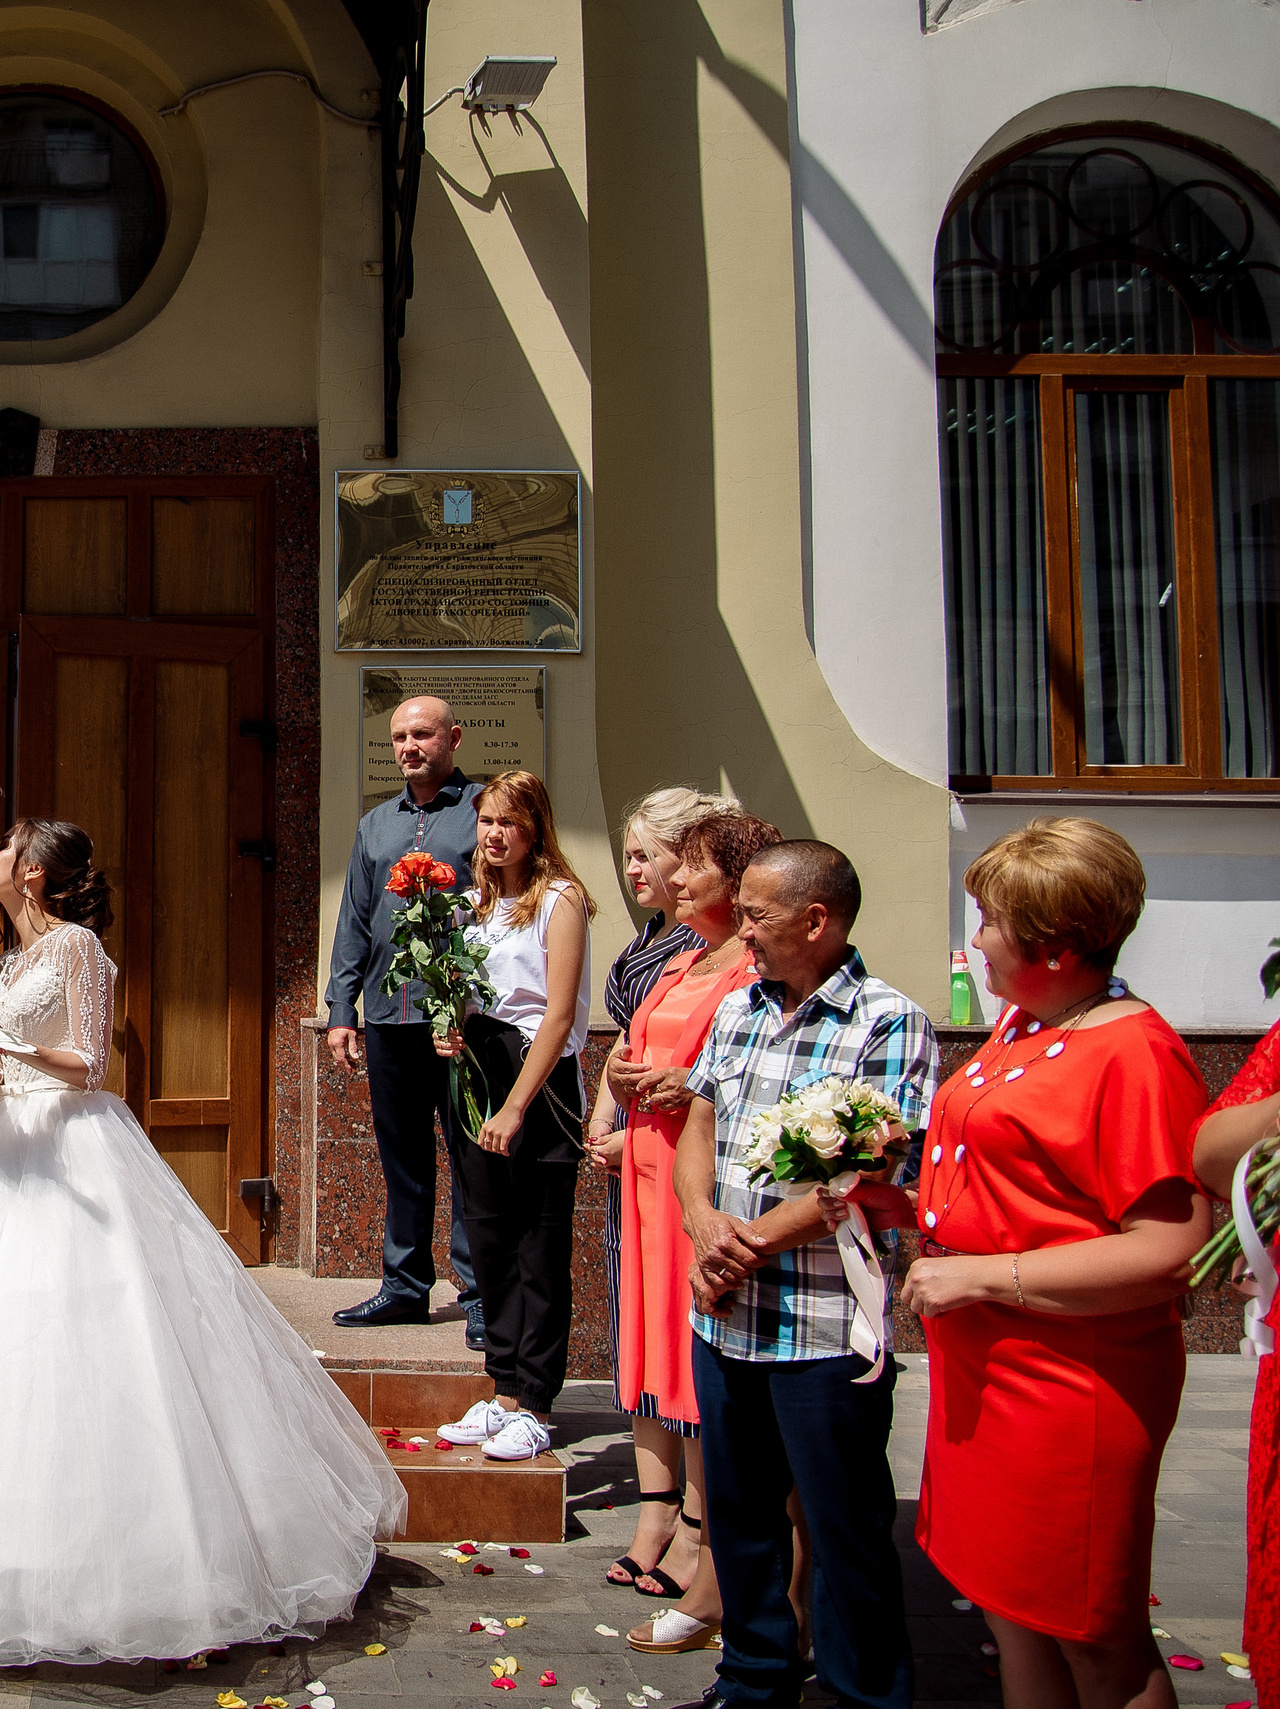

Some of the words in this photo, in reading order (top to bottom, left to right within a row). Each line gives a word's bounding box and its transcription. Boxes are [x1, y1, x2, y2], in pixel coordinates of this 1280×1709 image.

[416, 540, 497, 552] Управление
[377, 577, 503, 587] СПЕЦИАЛИЗИРОВАННЫЙ
[505, 578, 538, 587] ОТДЕЛ
[372, 587, 472, 596] ГОСУДАРСТВЕННОЙ
[474, 588, 546, 597] РЕГИСТРАЦИИ
[369, 598, 403, 607] АКТОВ
[404, 599, 486, 607] ГРАЖДАНСКОГО
[487, 599, 550, 607] СОСТОЯНИЯ
[455, 719, 506, 728] РАБОТЫ
[369, 758, 397, 766] Переры
